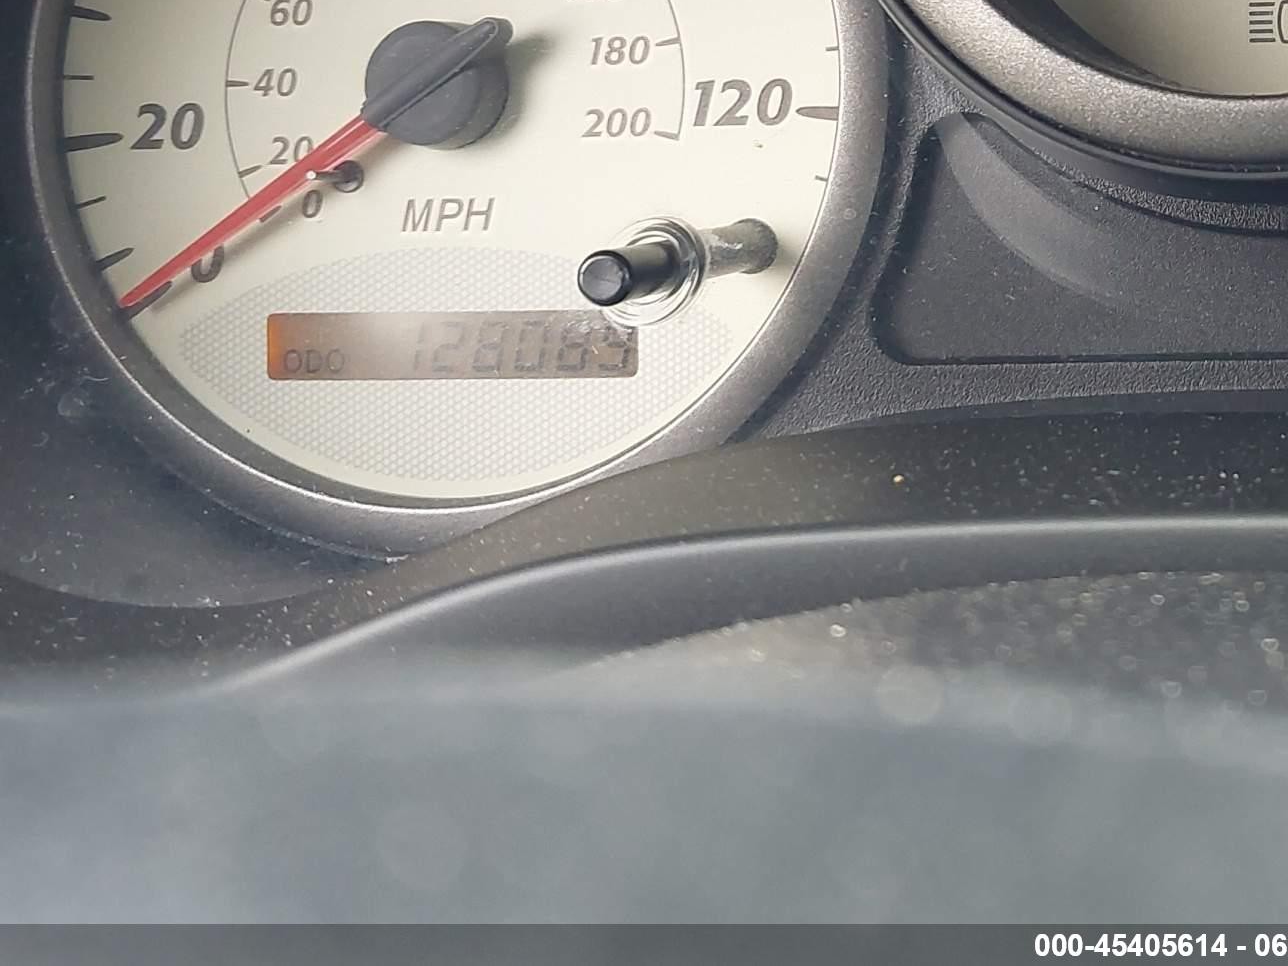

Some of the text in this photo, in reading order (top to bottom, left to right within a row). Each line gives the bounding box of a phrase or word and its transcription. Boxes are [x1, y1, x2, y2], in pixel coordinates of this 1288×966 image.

[589, 34, 650, 67] 180
[252, 67, 298, 98] 40
[692, 77, 794, 128] 120
[131, 103, 203, 150] 20
[583, 107, 652, 138] 200
[302, 189, 324, 218] 0
[401, 196, 494, 234] MPH
[283, 348, 346, 375] ODO
